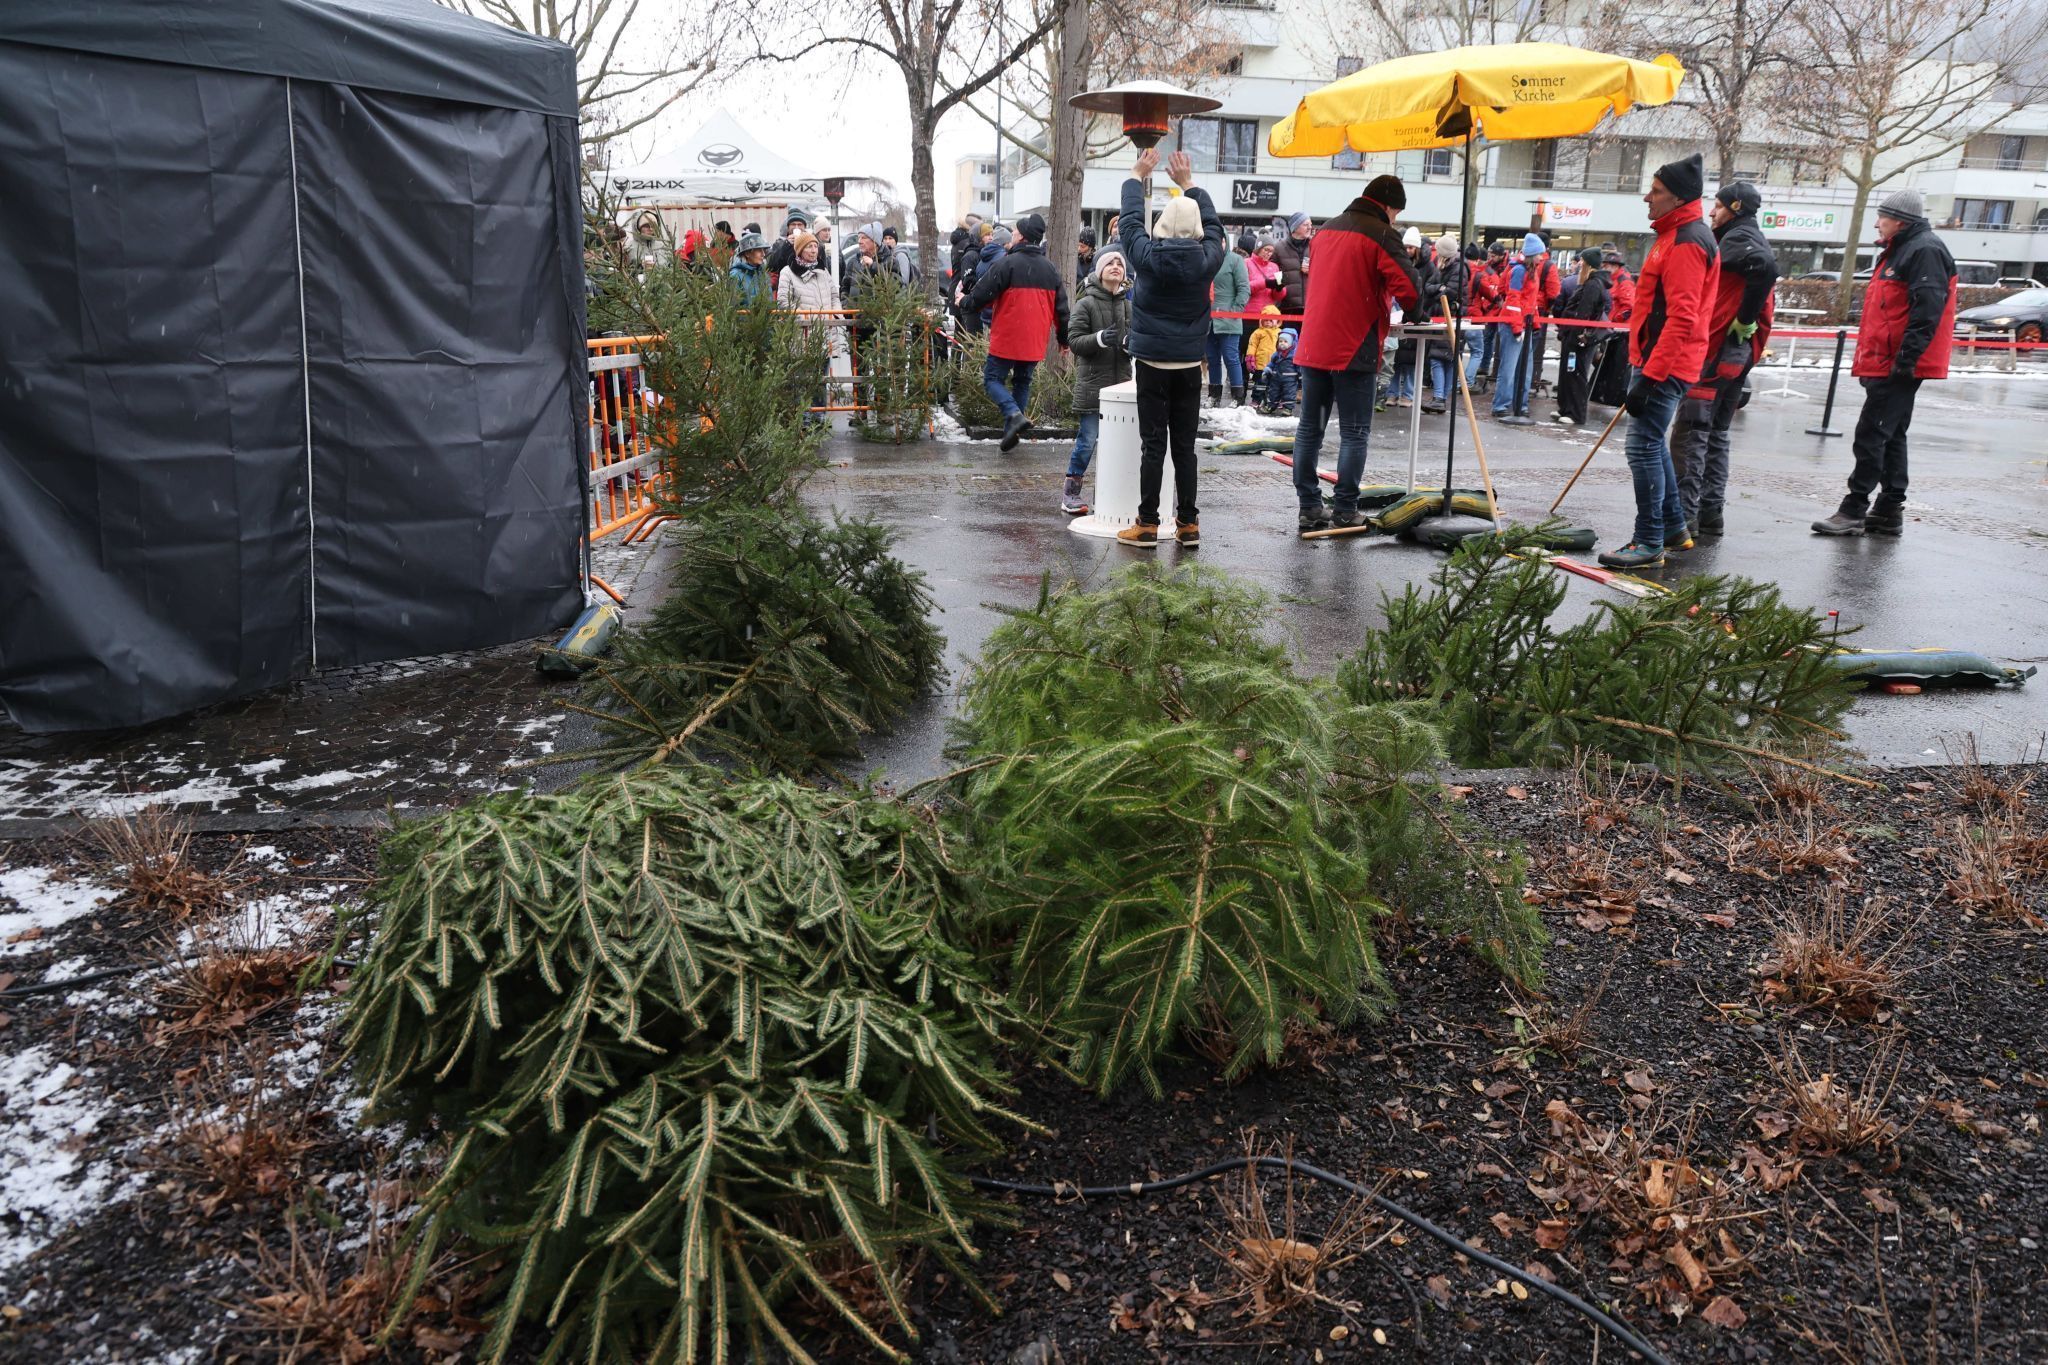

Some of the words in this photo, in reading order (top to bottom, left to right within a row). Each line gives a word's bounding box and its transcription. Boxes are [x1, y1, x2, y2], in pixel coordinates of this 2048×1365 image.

[1511, 74, 1566, 88] Sommer
[1513, 88, 1555, 102] Kirche
[631, 179, 686, 190] 24MX
[763, 181, 817, 193] 24MX
[1565, 206, 1591, 217] happy
[1787, 216, 1822, 228] HOCH
